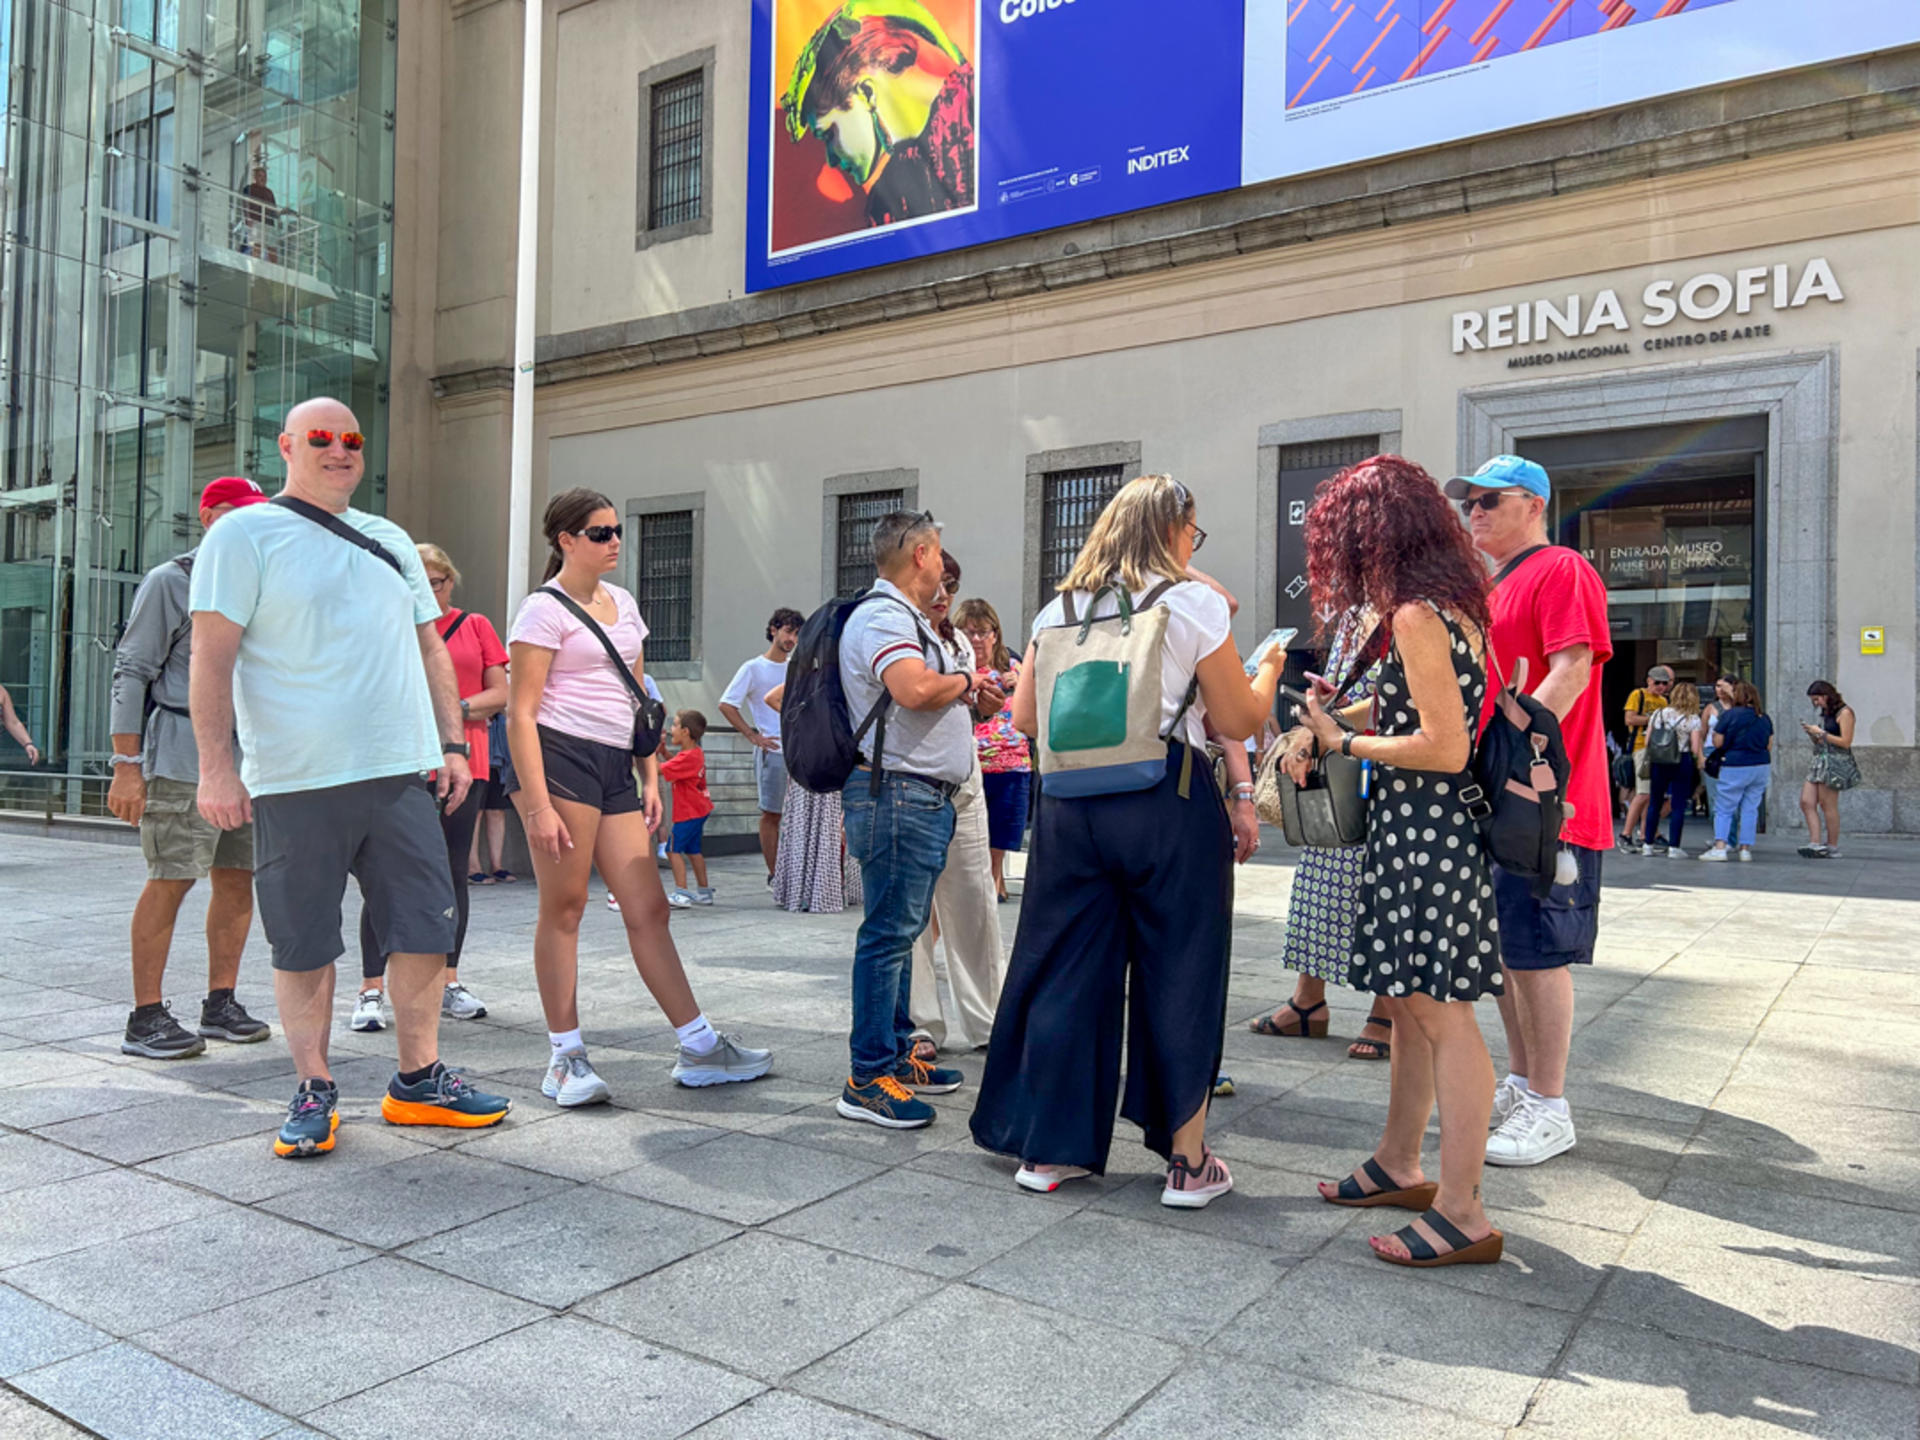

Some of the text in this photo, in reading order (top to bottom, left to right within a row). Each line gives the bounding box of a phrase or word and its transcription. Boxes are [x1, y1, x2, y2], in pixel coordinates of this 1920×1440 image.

[1127, 145, 1190, 175] INDITEX
[1451, 257, 1846, 354] REINA SOFIA
[1507, 324, 1771, 369] MUSEO NACIONAL CENTRO DE ARTE
[1608, 553, 1744, 573] MUSEUM ENTRANCE
[1609, 544, 1670, 560] ENTRADA
[1673, 541, 1723, 556] MUSEO
